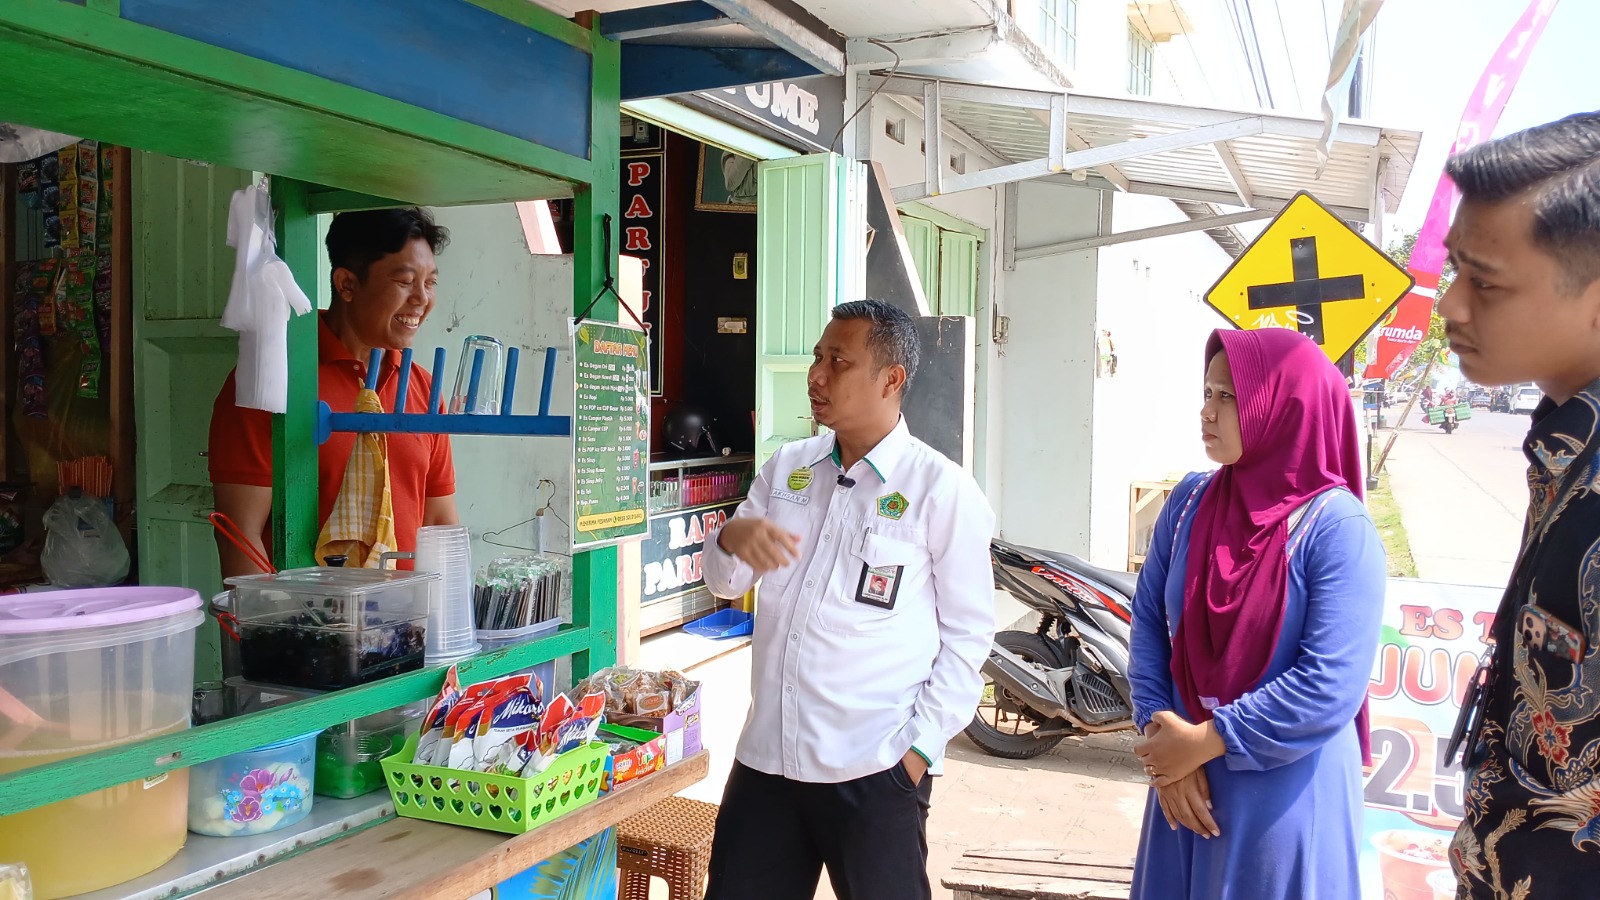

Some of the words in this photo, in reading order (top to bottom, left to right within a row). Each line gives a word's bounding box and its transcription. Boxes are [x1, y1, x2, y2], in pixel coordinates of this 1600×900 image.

[1380, 325, 1423, 341] rumda
[594, 340, 622, 356] DAFTAR
[1398, 604, 1464, 640] ES
